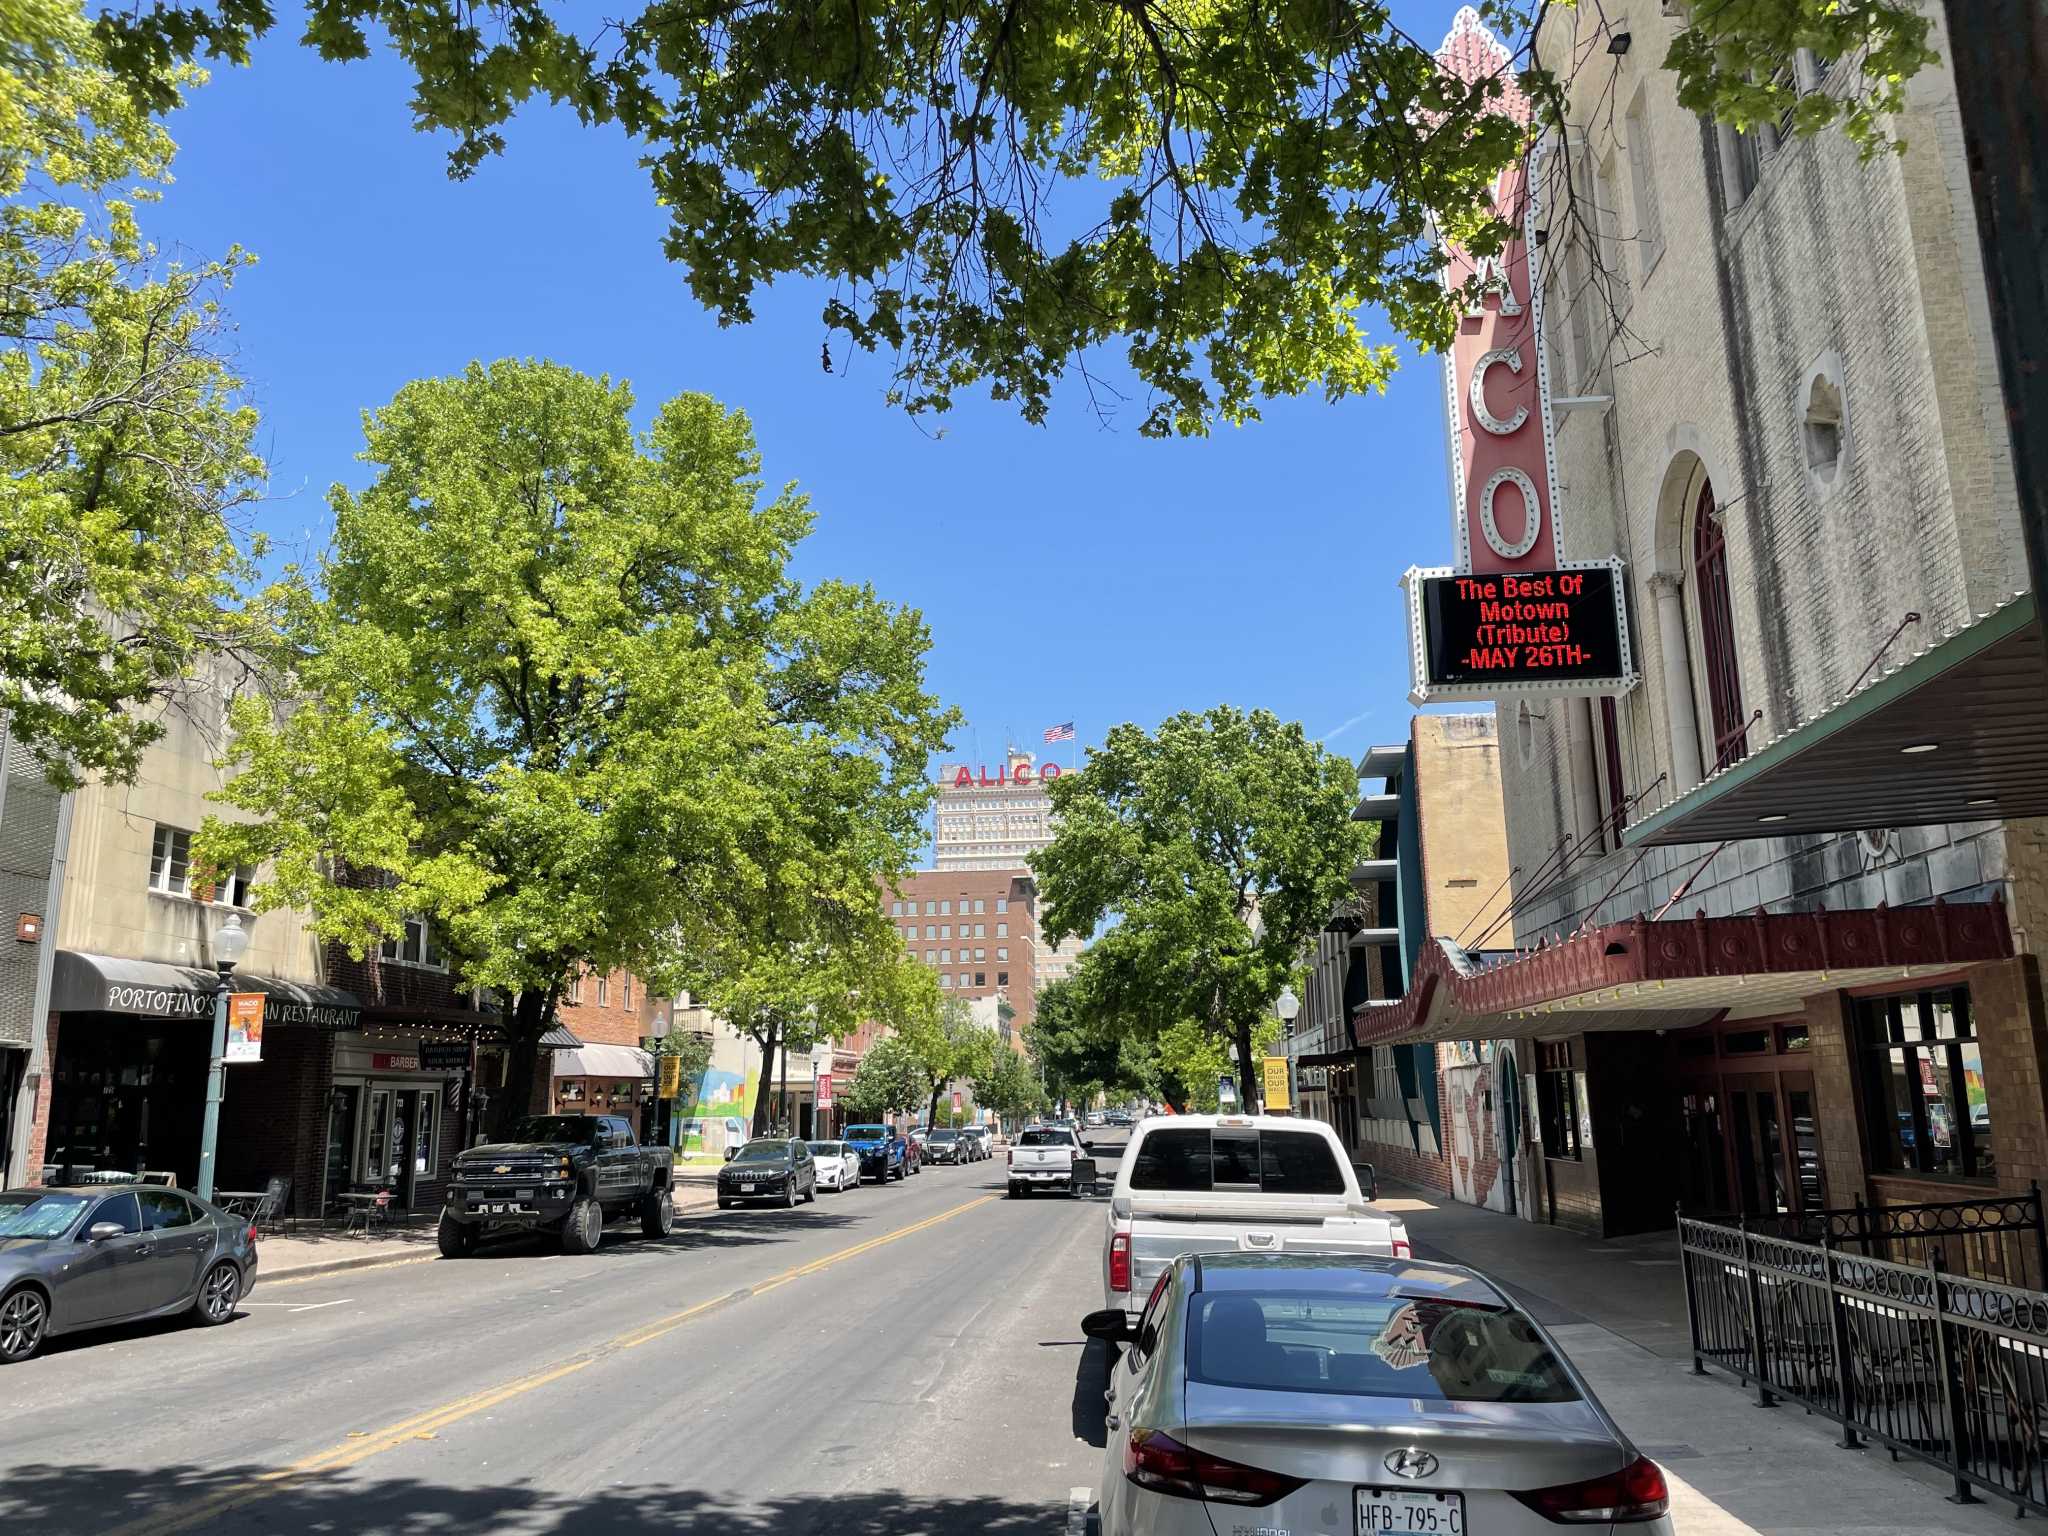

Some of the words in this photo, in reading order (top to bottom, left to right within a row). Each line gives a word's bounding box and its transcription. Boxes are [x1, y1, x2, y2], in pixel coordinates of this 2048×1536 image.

[1463, 165, 1541, 560] ACO
[1455, 578, 1497, 600] The
[1503, 575, 1554, 598] Best
[1560, 574, 1583, 596] Of
[1480, 600, 1569, 622] Motown
[1476, 623, 1569, 646] (Tribute)
[1461, 647, 1519, 669] -MAY
[1525, 644, 1592, 667] 26TH-
[954, 763, 1061, 788] ALICO
[108, 986, 217, 1020] PORTOFINO'S
[282, 1004, 361, 1027] RESTAURANT
[1360, 1503, 1460, 1534] HFB-795-C
